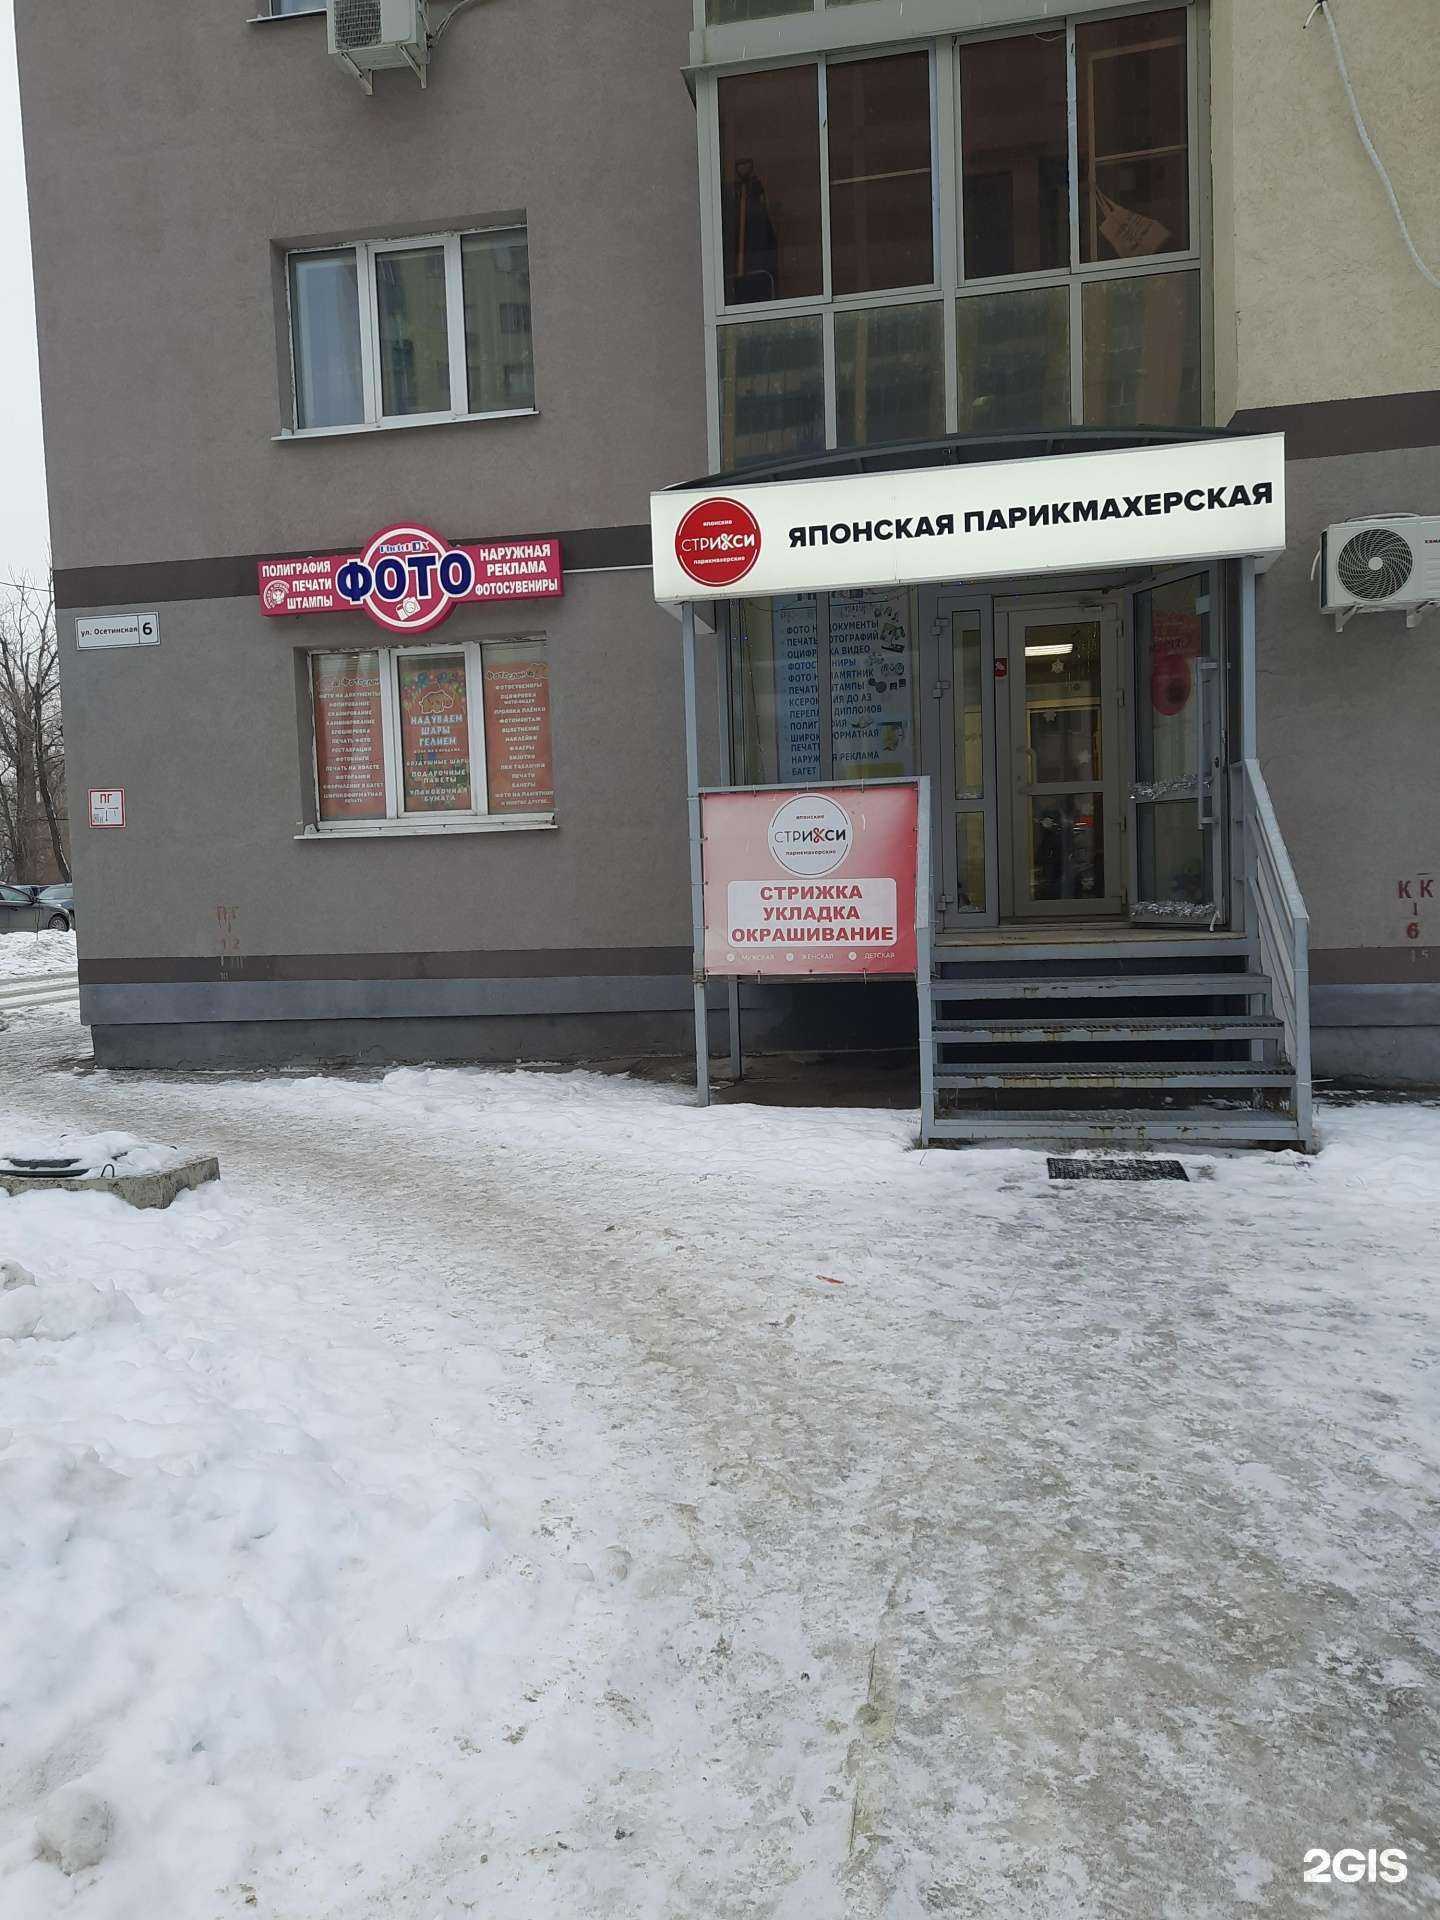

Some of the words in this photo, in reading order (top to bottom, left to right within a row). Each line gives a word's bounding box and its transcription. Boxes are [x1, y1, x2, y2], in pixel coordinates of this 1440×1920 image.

[788, 513, 954, 548] ЯПОНСКАЯ
[964, 481, 1273, 533] ПАРИКМАХЕРСКАЯ
[480, 543, 551, 562] НАРУЖНАЯ
[262, 560, 331, 578] ПОЛИГРАФИЯ
[486, 560, 548, 577] РЕКЛАМА
[335, 550, 475, 605] ФОТО
[292, 578, 332, 593] ПЕЧАТИ
[475, 578, 558, 596] ФОТОСУВЕНИРЫ
[287, 595, 333, 610] ШТАМПЫ
[80, 628, 92, 637] ул.
[94, 626, 138, 636] Осетинская
[142, 621, 153, 636] 6
[787, 625, 810, 635] ФОТО
[830, 631, 879, 644] ОТОГРАФИЙ
[841, 644, 871, 656] ВИДЕО
[788, 672, 812, 682] ФОТО
[831, 681, 865, 692] ТАМПЫ
[846, 695, 859, 704] ДО
[834, 704, 882, 717] ДИПЛОМОВ
[411, 714, 463, 725] НАДУВАЕМ
[422, 726, 450, 735] ШАРЫ
[790, 729, 879, 742] ШИРОКОРМАТНАЯ
[420, 737, 456, 745] ГЕЛИЕМ
[840, 750, 879, 761] РЕКЛАМА
[792, 766, 816, 776] БАГЕТ
[100, 793, 113, 804] ПГ
[760, 885, 863, 901] СТРИЖКА
[763, 906, 861, 922] УКЛАДКА
[731, 926, 894, 943] ОКРАШИВАНИЕ
[864, 951, 895, 961] ДЕТСКАЯ
